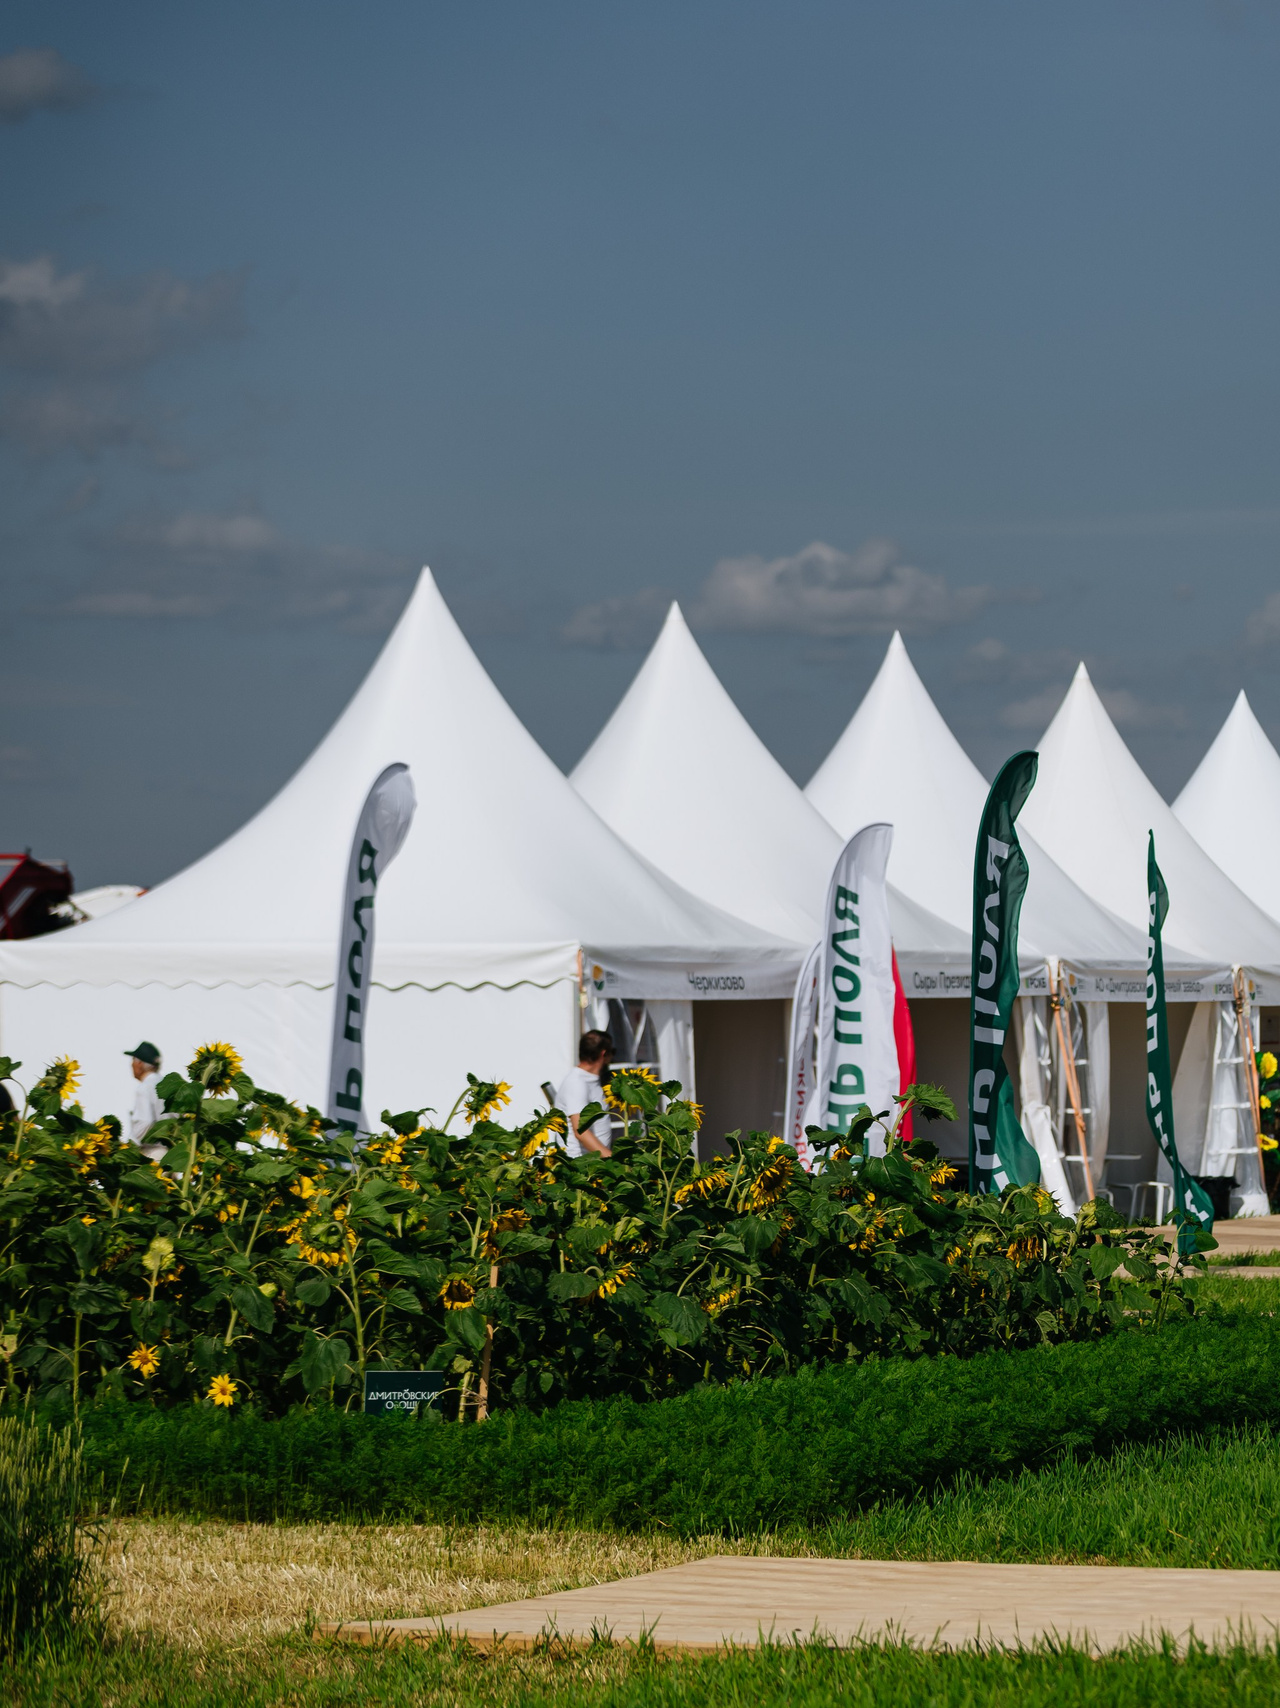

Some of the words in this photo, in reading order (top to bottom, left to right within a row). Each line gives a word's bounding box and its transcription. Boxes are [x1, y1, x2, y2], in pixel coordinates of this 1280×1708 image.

[831, 884, 863, 1045] ПОЛЯ
[687, 971, 746, 995] Черкизово
[914, 972, 937, 994] Сыры
[1106, 977, 1147, 997] «Дмитровски
